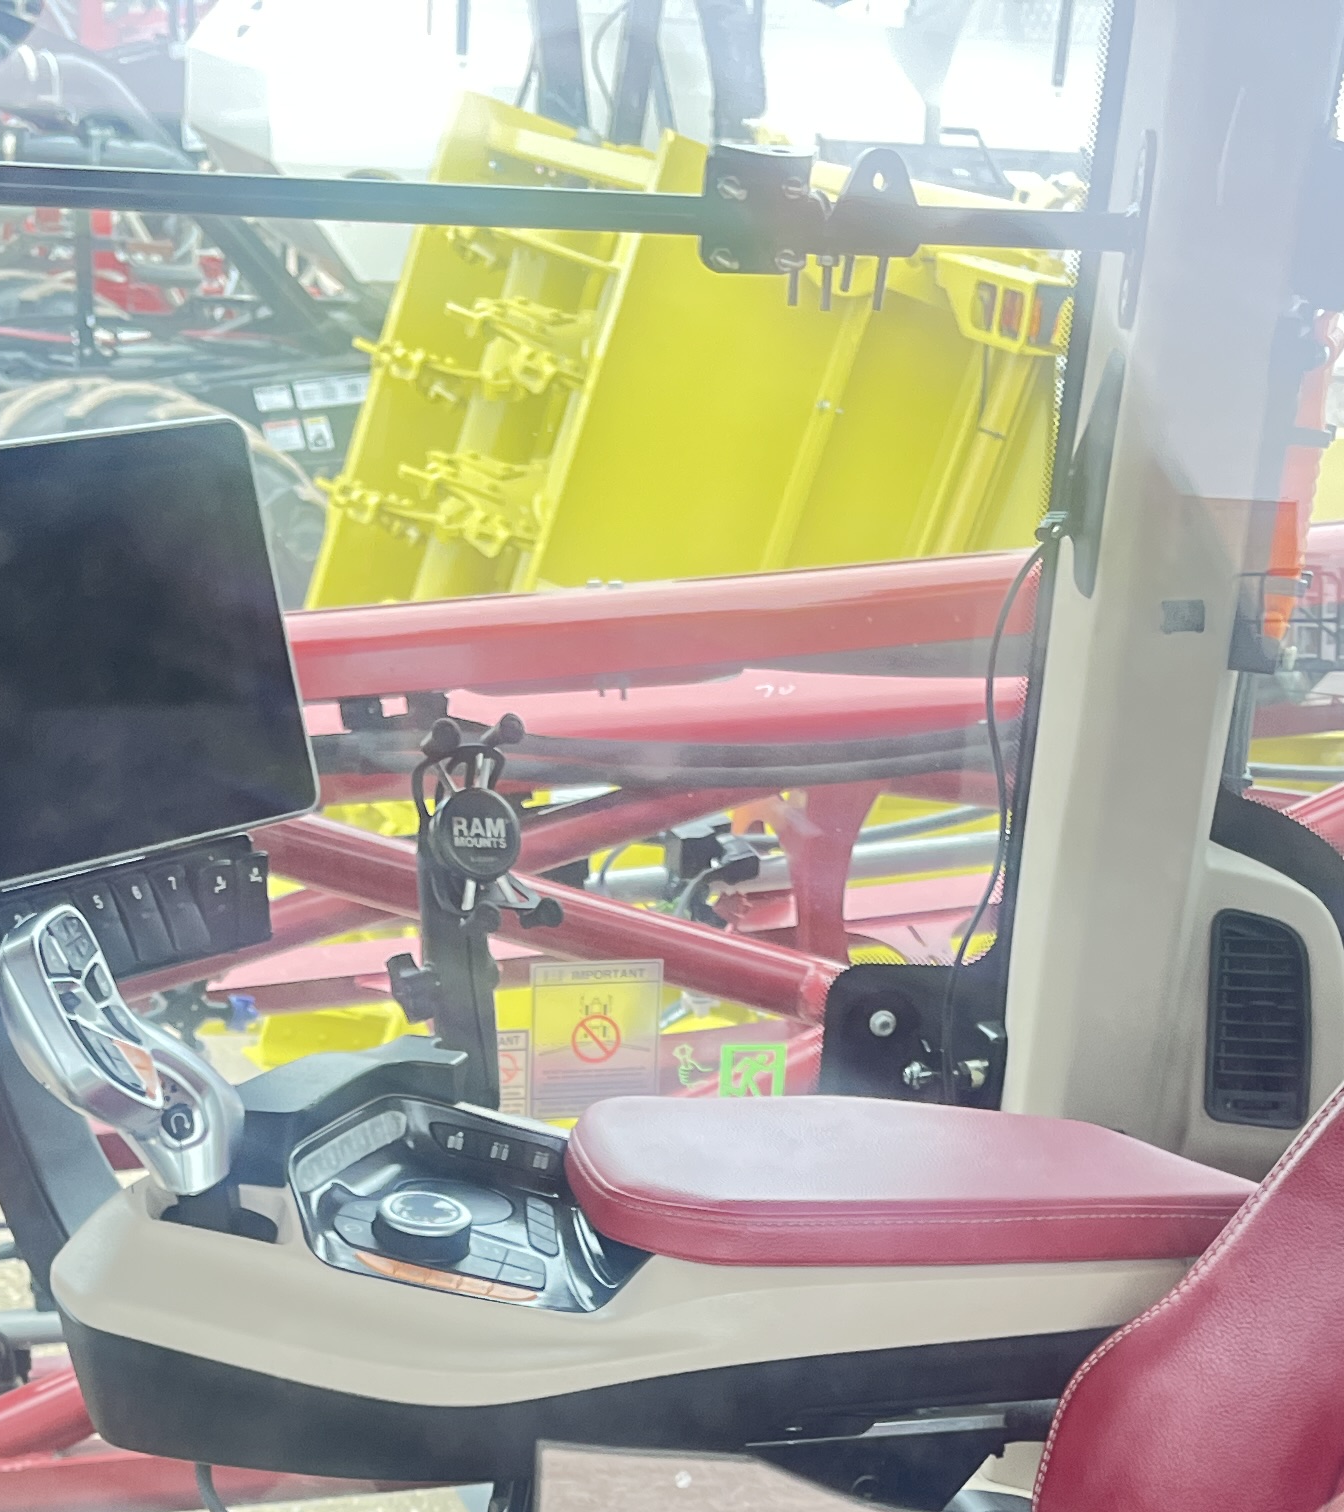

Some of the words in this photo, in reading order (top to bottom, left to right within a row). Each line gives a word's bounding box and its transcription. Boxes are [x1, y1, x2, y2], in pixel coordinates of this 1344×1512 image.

[452, 816, 507, 838] RAM
[454, 836, 507, 849] MOUNTS
[92, 894, 104, 910] 5
[131, 885, 143, 900] 6
[167, 875, 178, 890] 7
[571, 967, 647, 981] IMPORTANT
